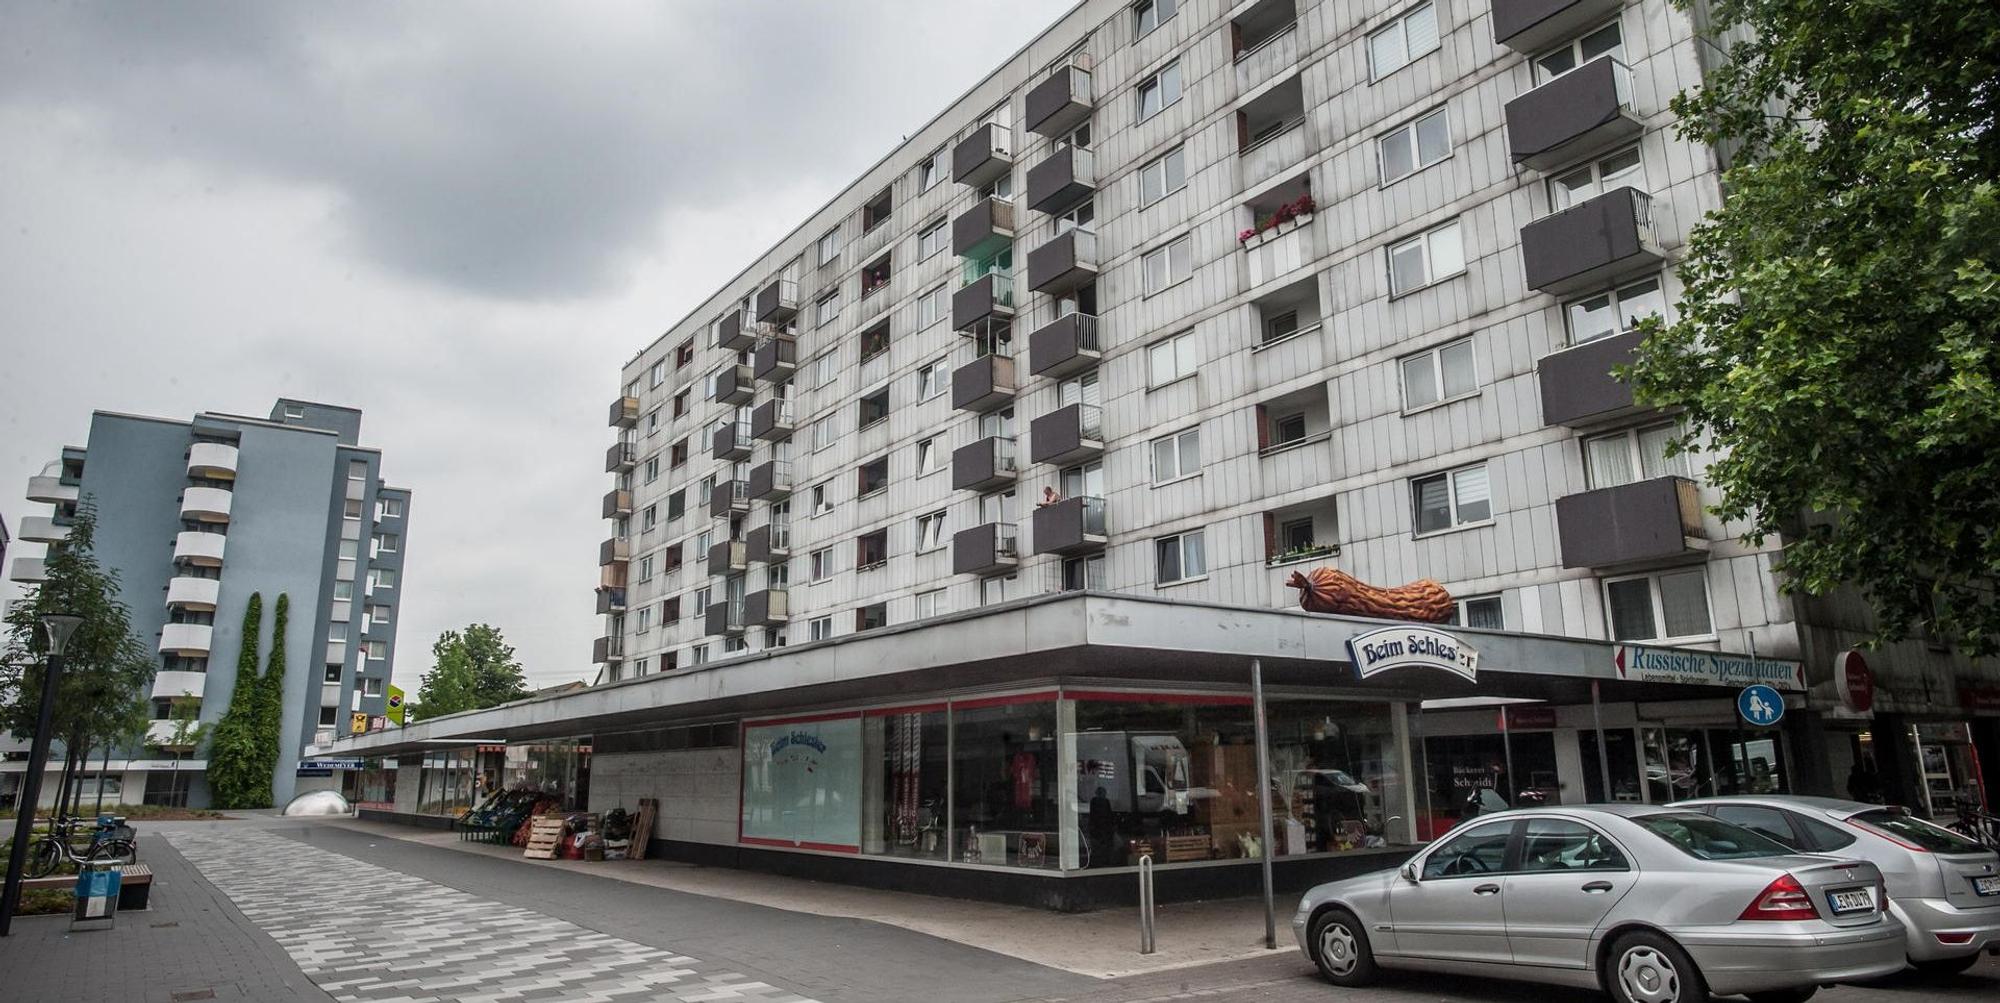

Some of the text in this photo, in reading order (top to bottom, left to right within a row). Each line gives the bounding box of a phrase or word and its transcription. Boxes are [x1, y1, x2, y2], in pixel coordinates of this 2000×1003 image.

[1362, 635, 1475, 672] Beim Schleser
[1632, 646, 1706, 674] Russische
